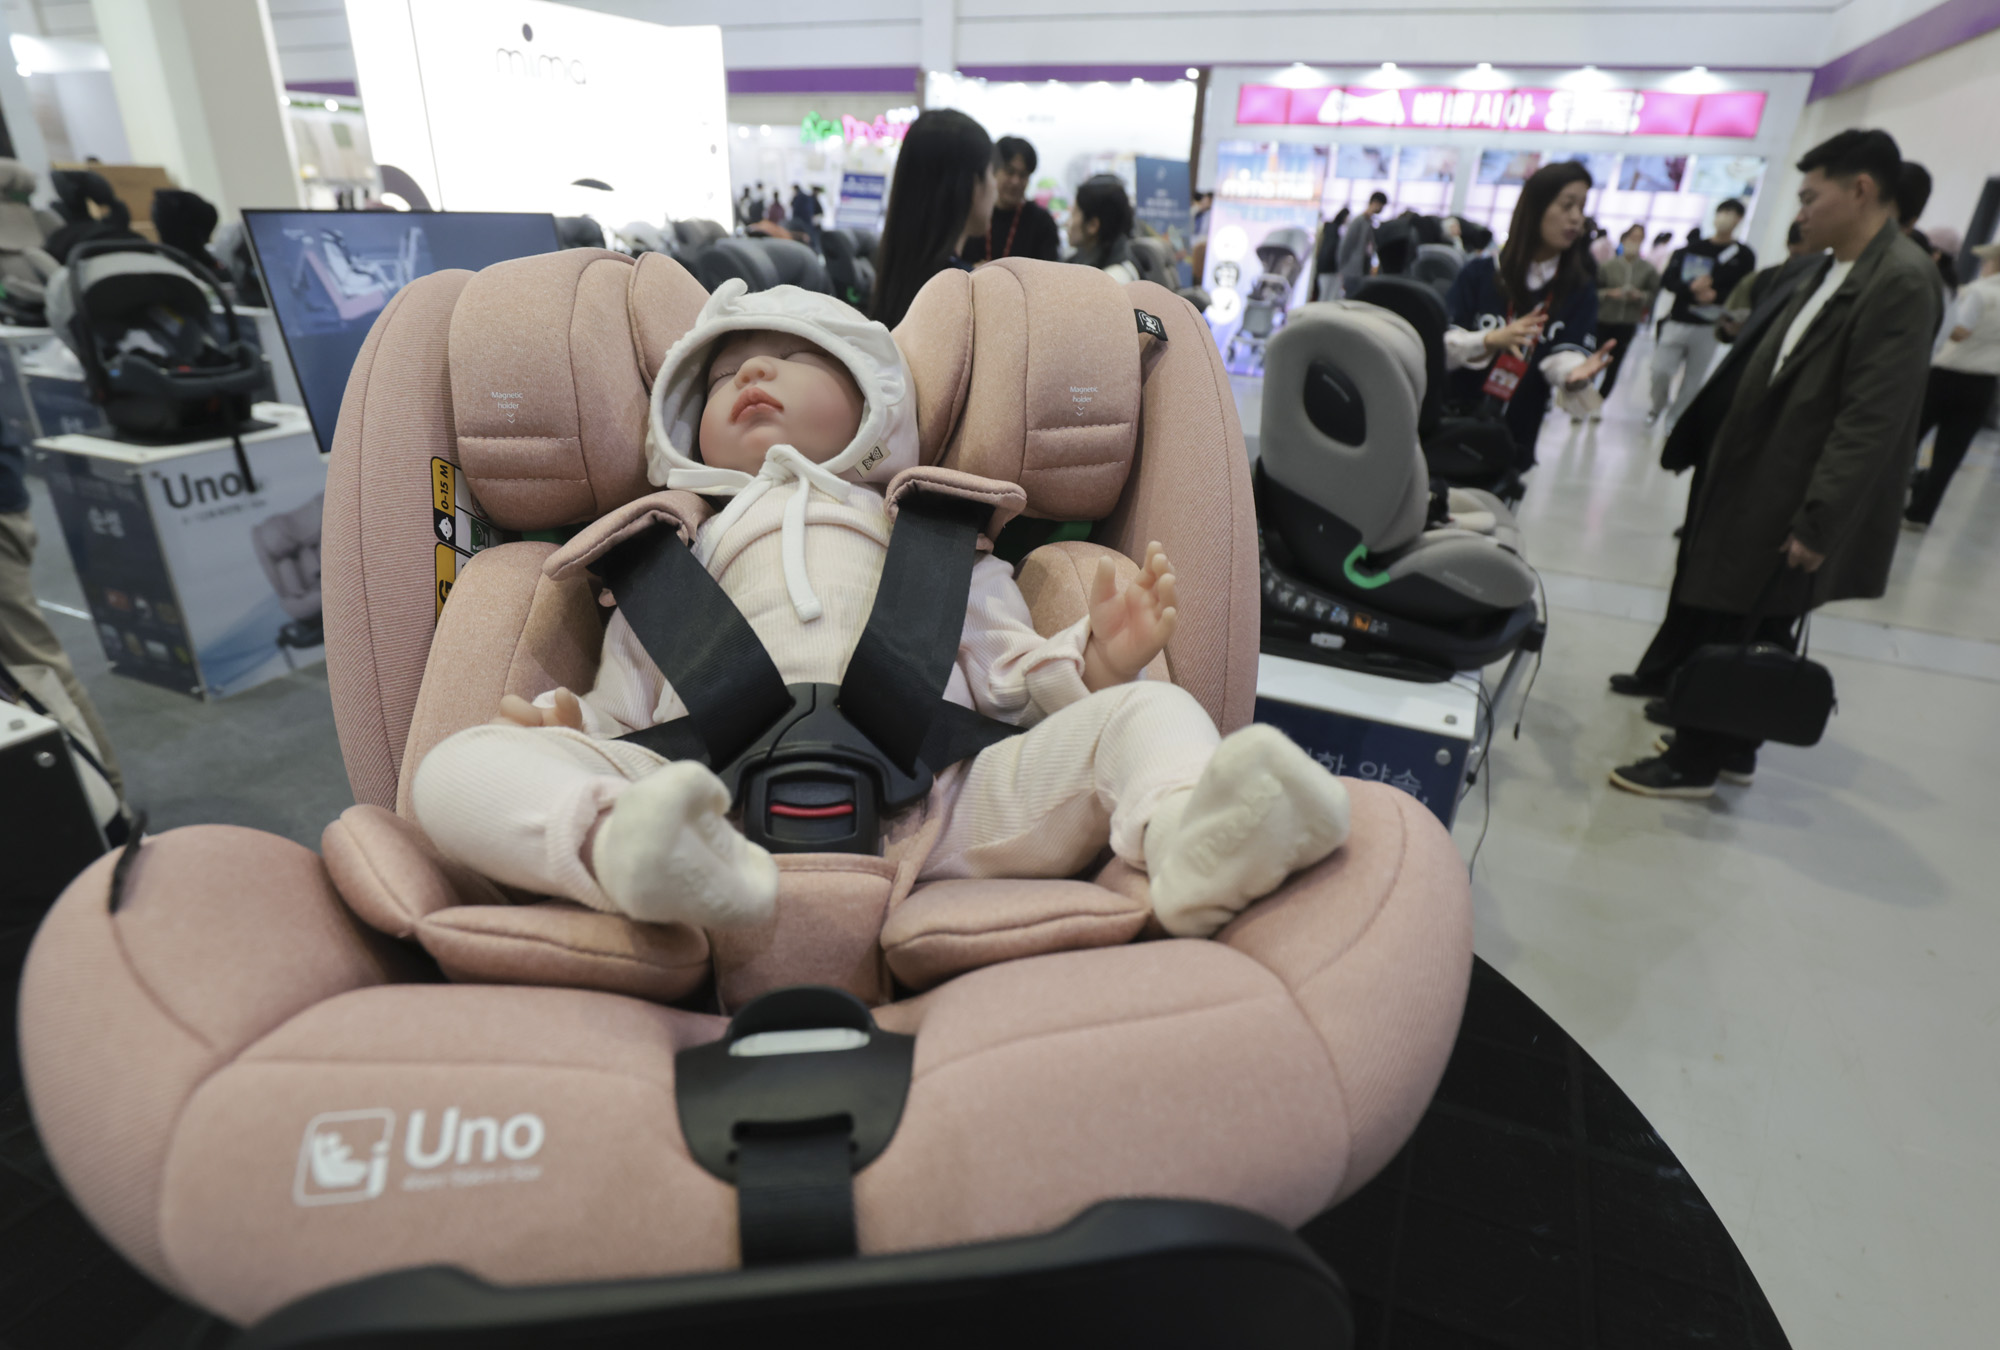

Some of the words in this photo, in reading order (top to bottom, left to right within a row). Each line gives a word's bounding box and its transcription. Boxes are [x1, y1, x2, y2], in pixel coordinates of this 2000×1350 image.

[496, 23, 586, 84] mima
[1069, 386, 1098, 394] Magnetic
[491, 391, 523, 400] Magnetic
[1072, 395, 1092, 403] holder
[497, 401, 519, 409] holder
[439, 464, 449, 475] M
[439, 481, 449, 511] 0-15
[404, 1106, 545, 1170] Uno
